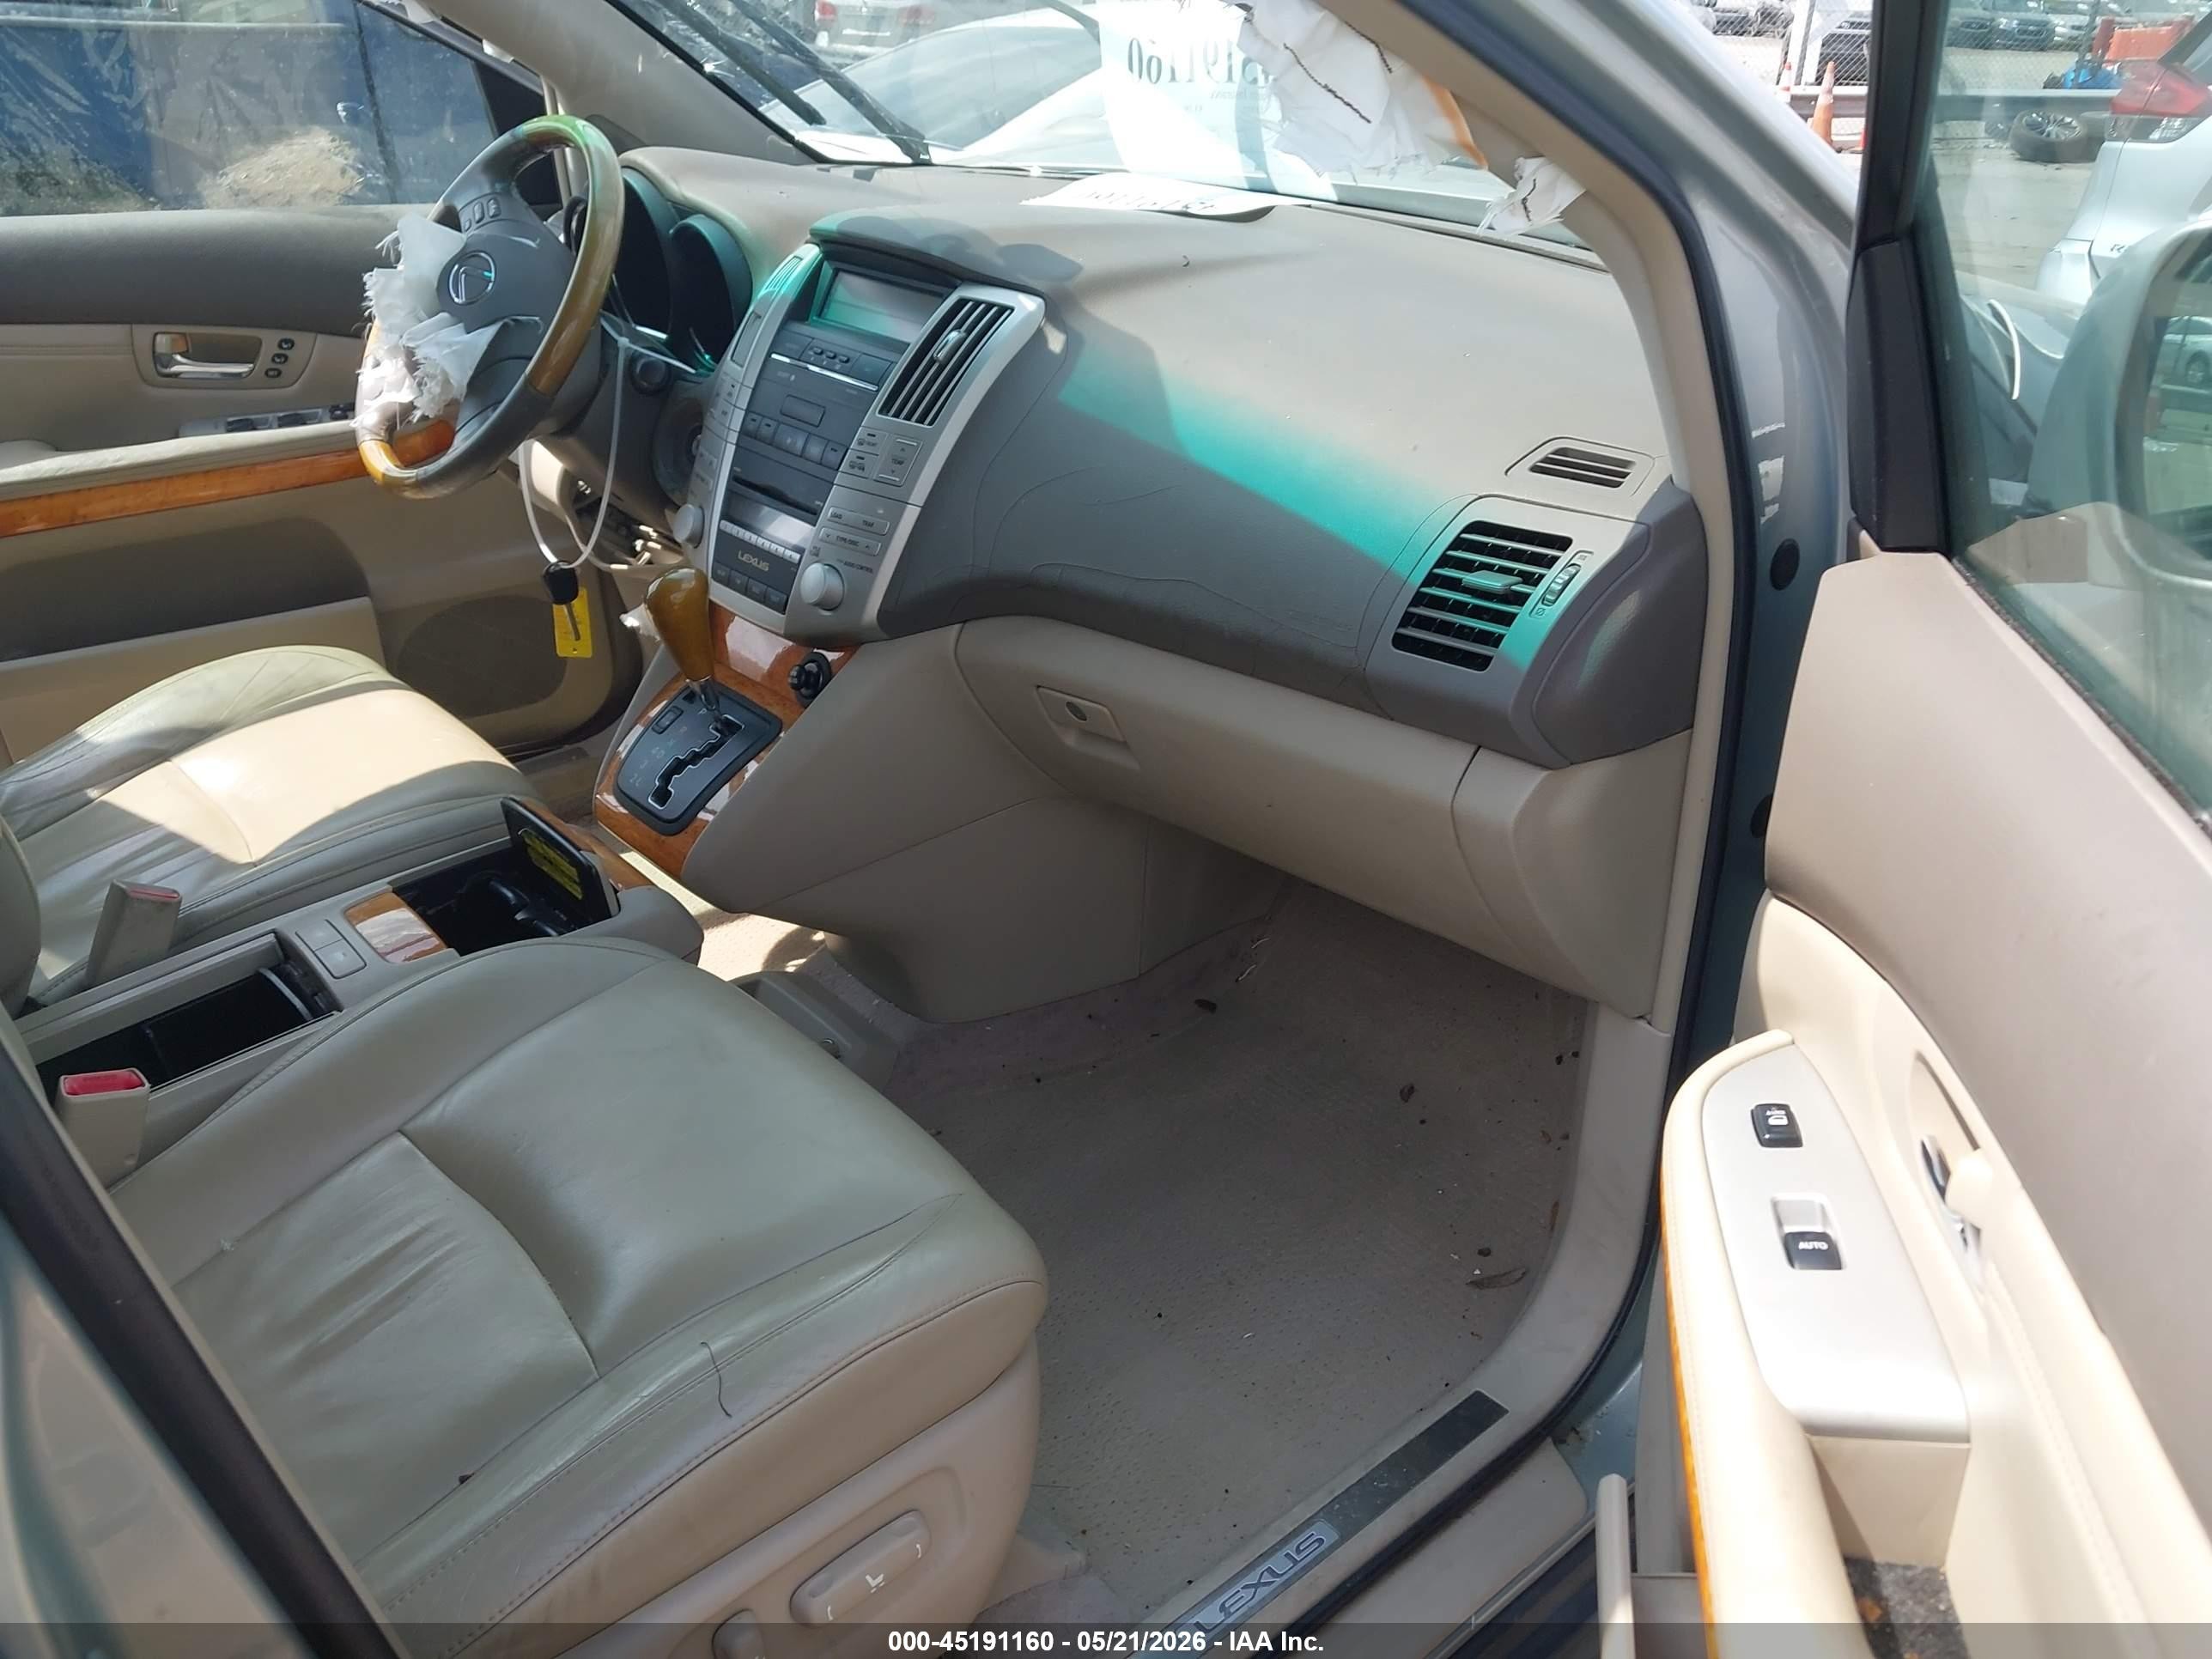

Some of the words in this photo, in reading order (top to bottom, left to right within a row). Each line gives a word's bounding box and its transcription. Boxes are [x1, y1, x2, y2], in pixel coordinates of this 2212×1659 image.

[738, 550, 769, 572] LEXUS
[1798, 1241, 1829, 1250] AUTO
[1192, 1531, 1327, 1632] LEXUS
